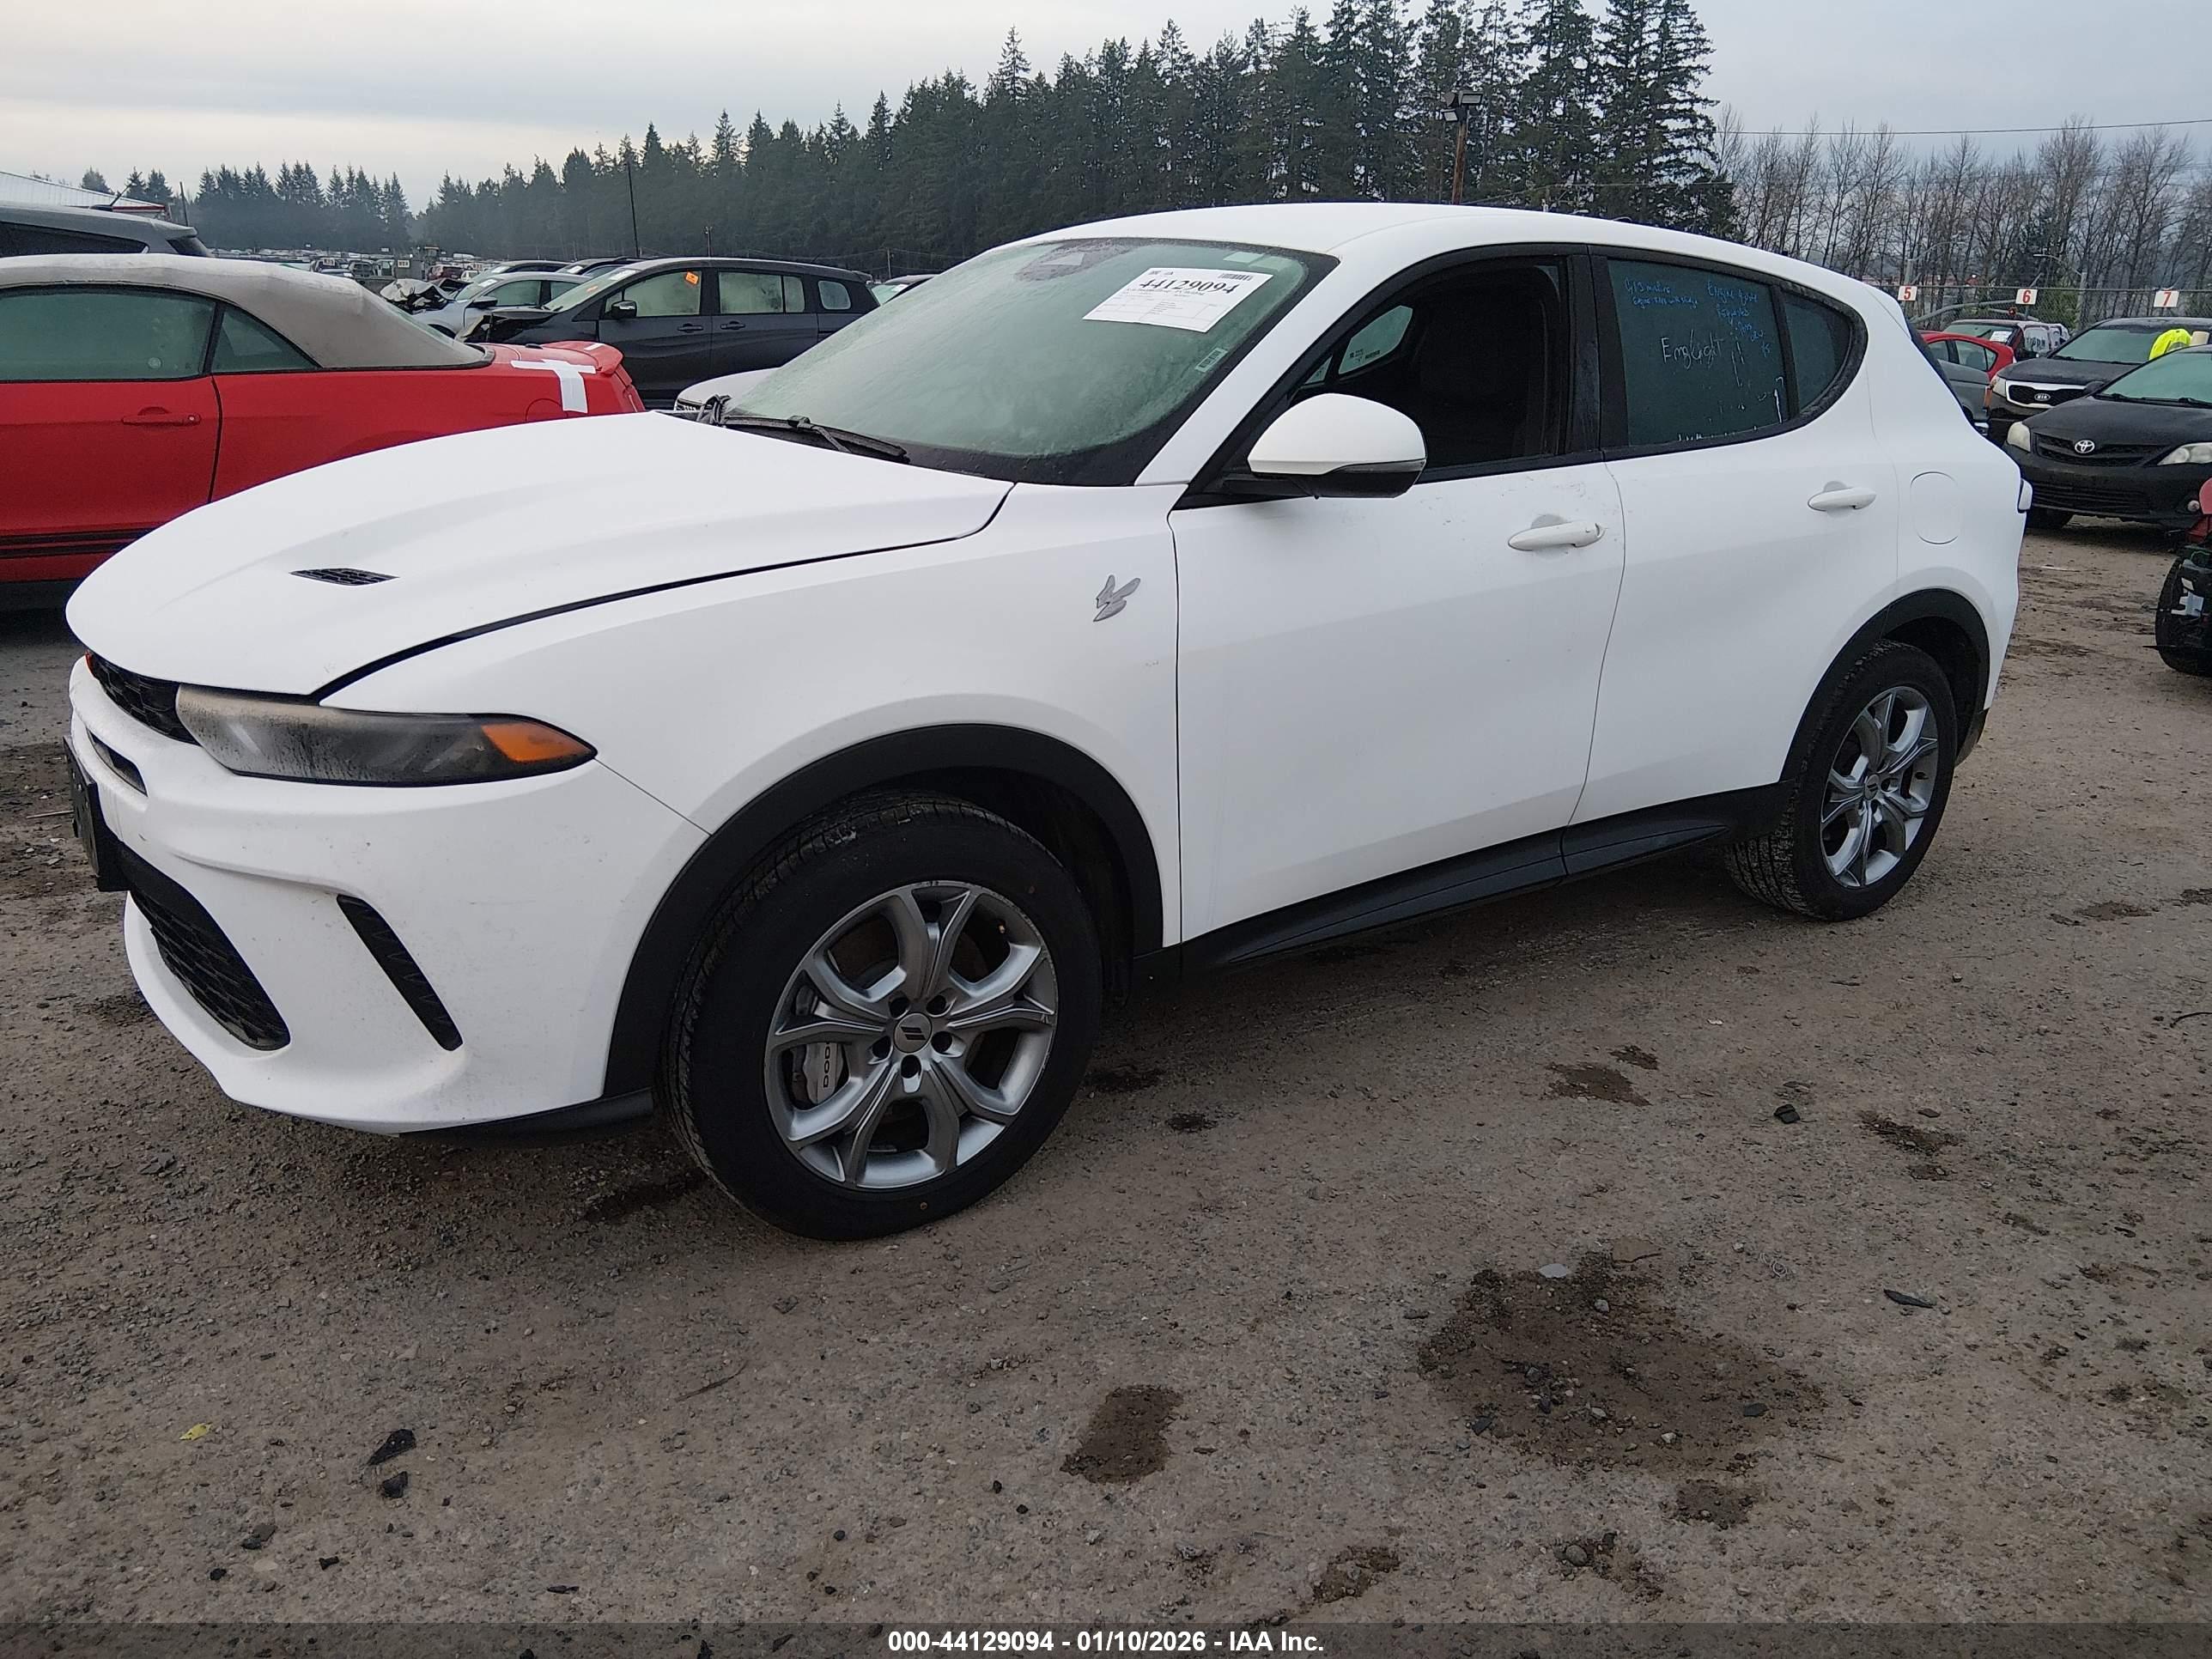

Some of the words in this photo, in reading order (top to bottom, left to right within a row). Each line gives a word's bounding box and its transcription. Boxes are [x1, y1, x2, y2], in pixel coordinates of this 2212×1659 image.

[1139, 277, 1241, 295] 44129094
[1903, 286, 1912, 300] 5
[2022, 290, 2032, 303] 6
[2162, 291, 2172, 306] 7
[823, 1042, 831, 1088] DOD
